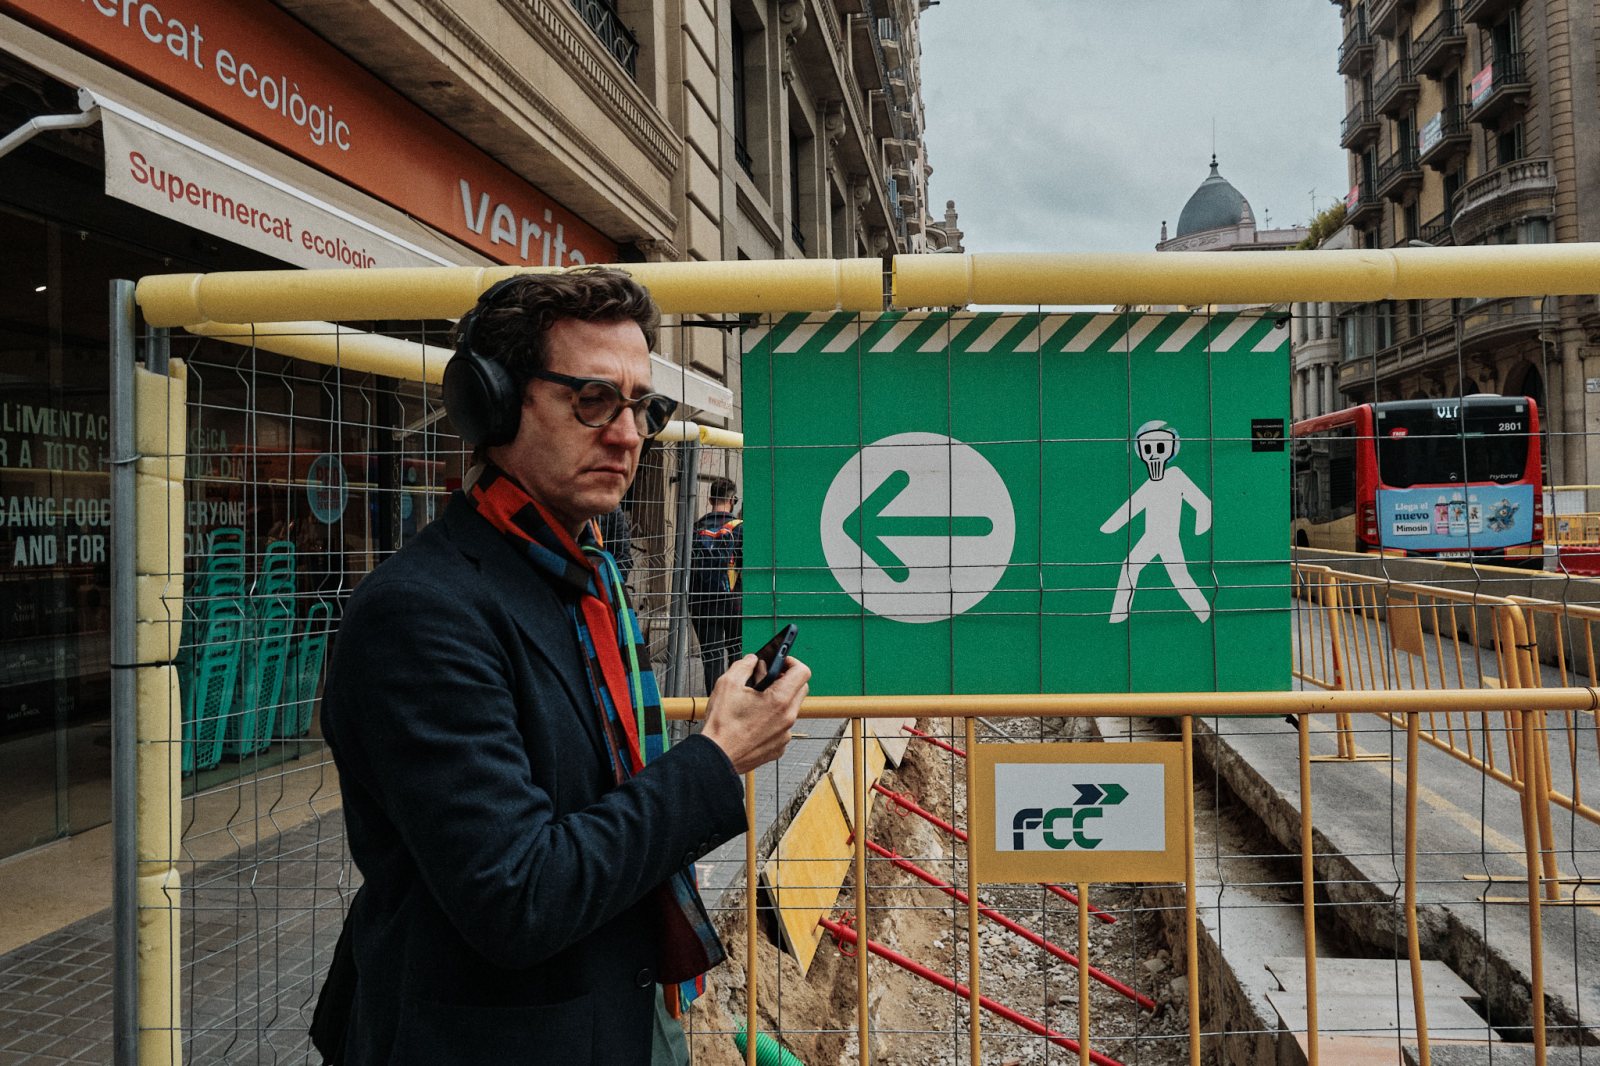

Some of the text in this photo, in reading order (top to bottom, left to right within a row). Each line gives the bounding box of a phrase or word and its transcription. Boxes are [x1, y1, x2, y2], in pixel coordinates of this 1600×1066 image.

[93, 0, 351, 151] ercat ecològic
[129, 151, 293, 243] Supermercat
[1498, 421, 1522, 431] 2801
[20, 440, 32, 468] A
[188, 500, 246, 527] ERYONE
[1395, 512, 1429, 520] nuevo
[13, 535, 57, 567] AND
[67, 535, 106, 565] FOR
[1012, 807, 1103, 850] FCC
